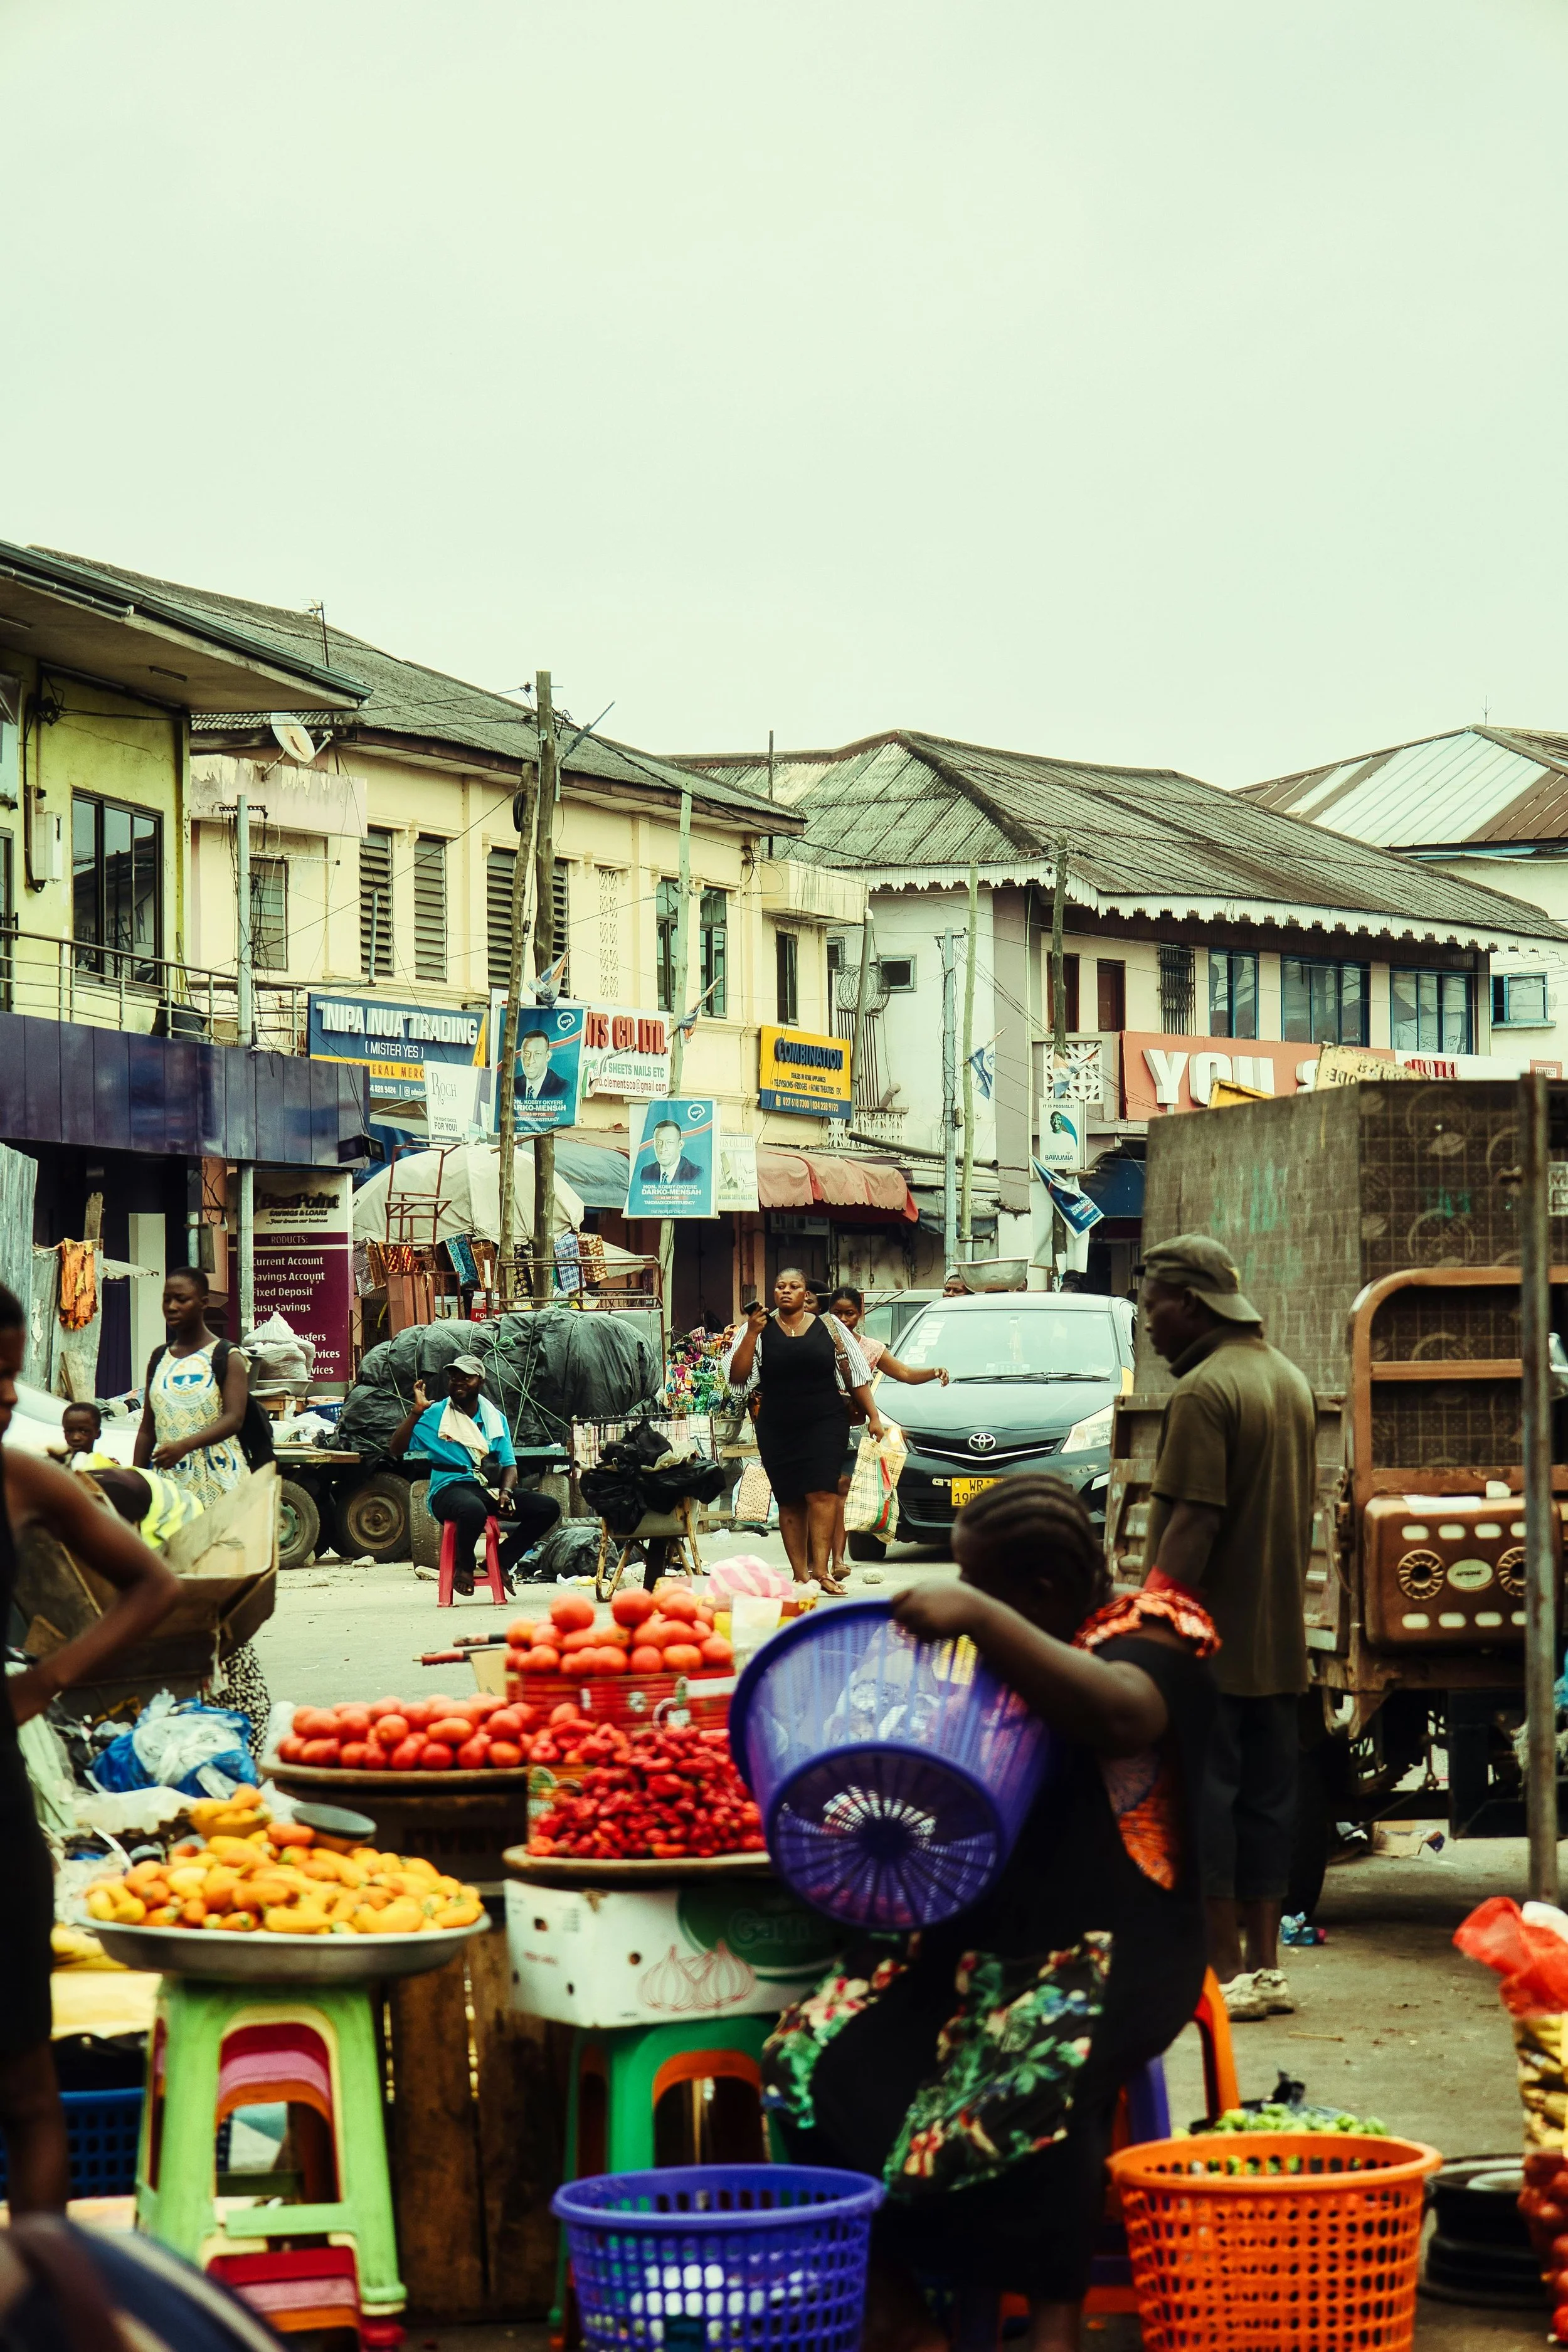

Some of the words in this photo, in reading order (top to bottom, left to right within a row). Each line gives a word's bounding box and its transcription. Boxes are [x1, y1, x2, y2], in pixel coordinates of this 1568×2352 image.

[408, 1012, 478, 1045] TRADING
[403, 1044, 418, 1058] YES
[774, 1037, 843, 1070] COMBINATION
[352, 1061, 395, 1076] ERAL
[608, 1062, 632, 1074] SHEETS
[633, 1065, 651, 1076] NAILS
[653, 1067, 664, 1078] ETC
[1411, 1059, 1461, 1079] HOTEL
[1537, 1068, 1555, 1076] CONTACT
[1142, 1049, 1275, 1106] YOU
[774, 1079, 793, 1089] TELEVISIONS
[434, 1121, 444, 1130] FOR
[445, 1123, 457, 1131] YOU!
[287, 1256, 324, 1265] Account
[253, 1273, 286, 1282] Savings
[289, 1272, 325, 1281] Account
[278, 1287, 313, 1298] Deposit
[275, 1302, 310, 1313] Savings
[969, 1480, 983, 1491] WR
